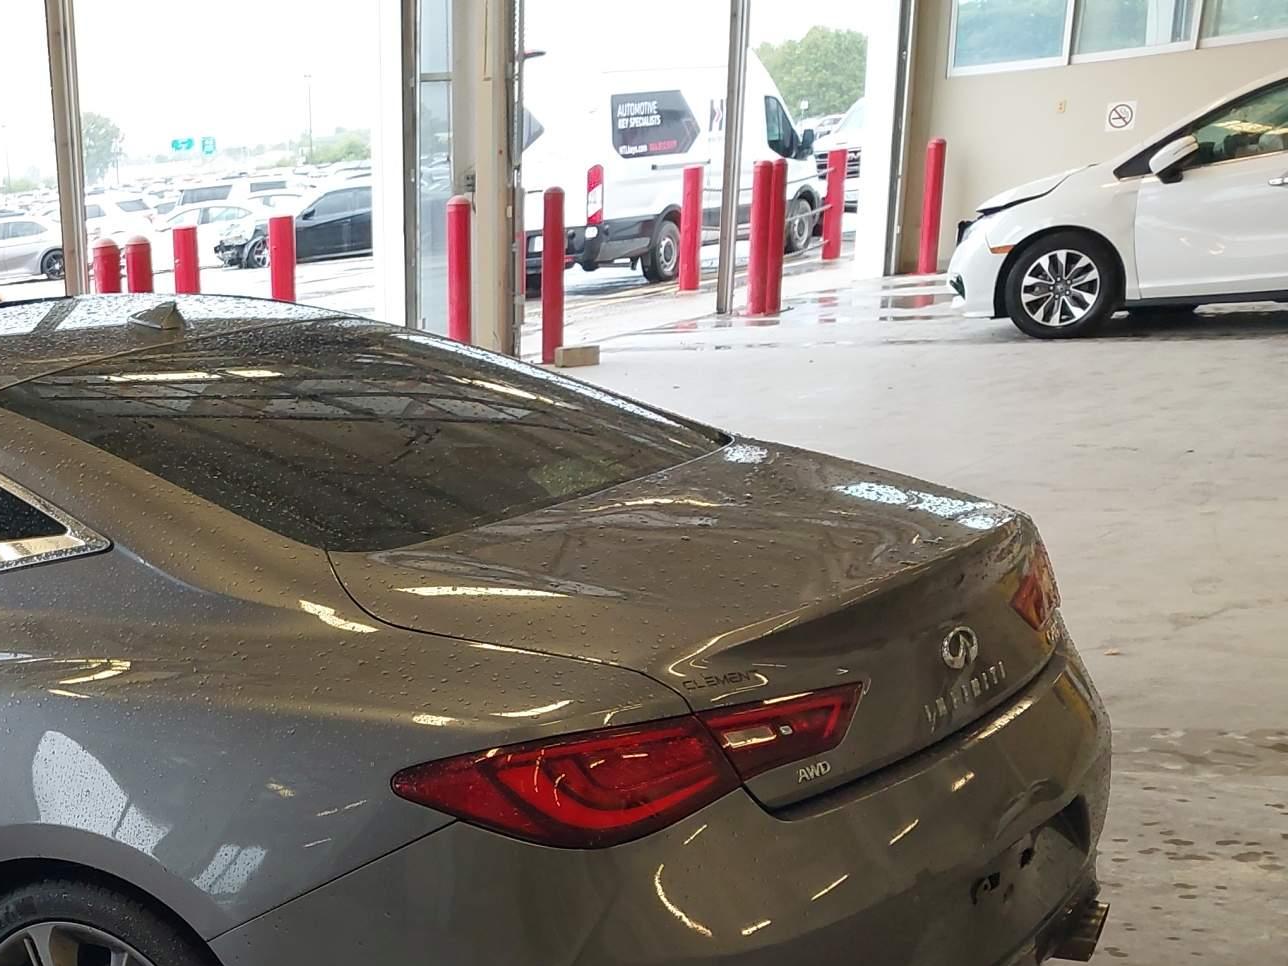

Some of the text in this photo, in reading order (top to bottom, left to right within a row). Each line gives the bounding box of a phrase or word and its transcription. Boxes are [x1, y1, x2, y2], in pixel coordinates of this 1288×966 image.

[617, 101, 658, 117] AUTOMOTIVE
[629, 114, 661, 128] SPECIALISTS
[797, 760, 831, 784] AWD
